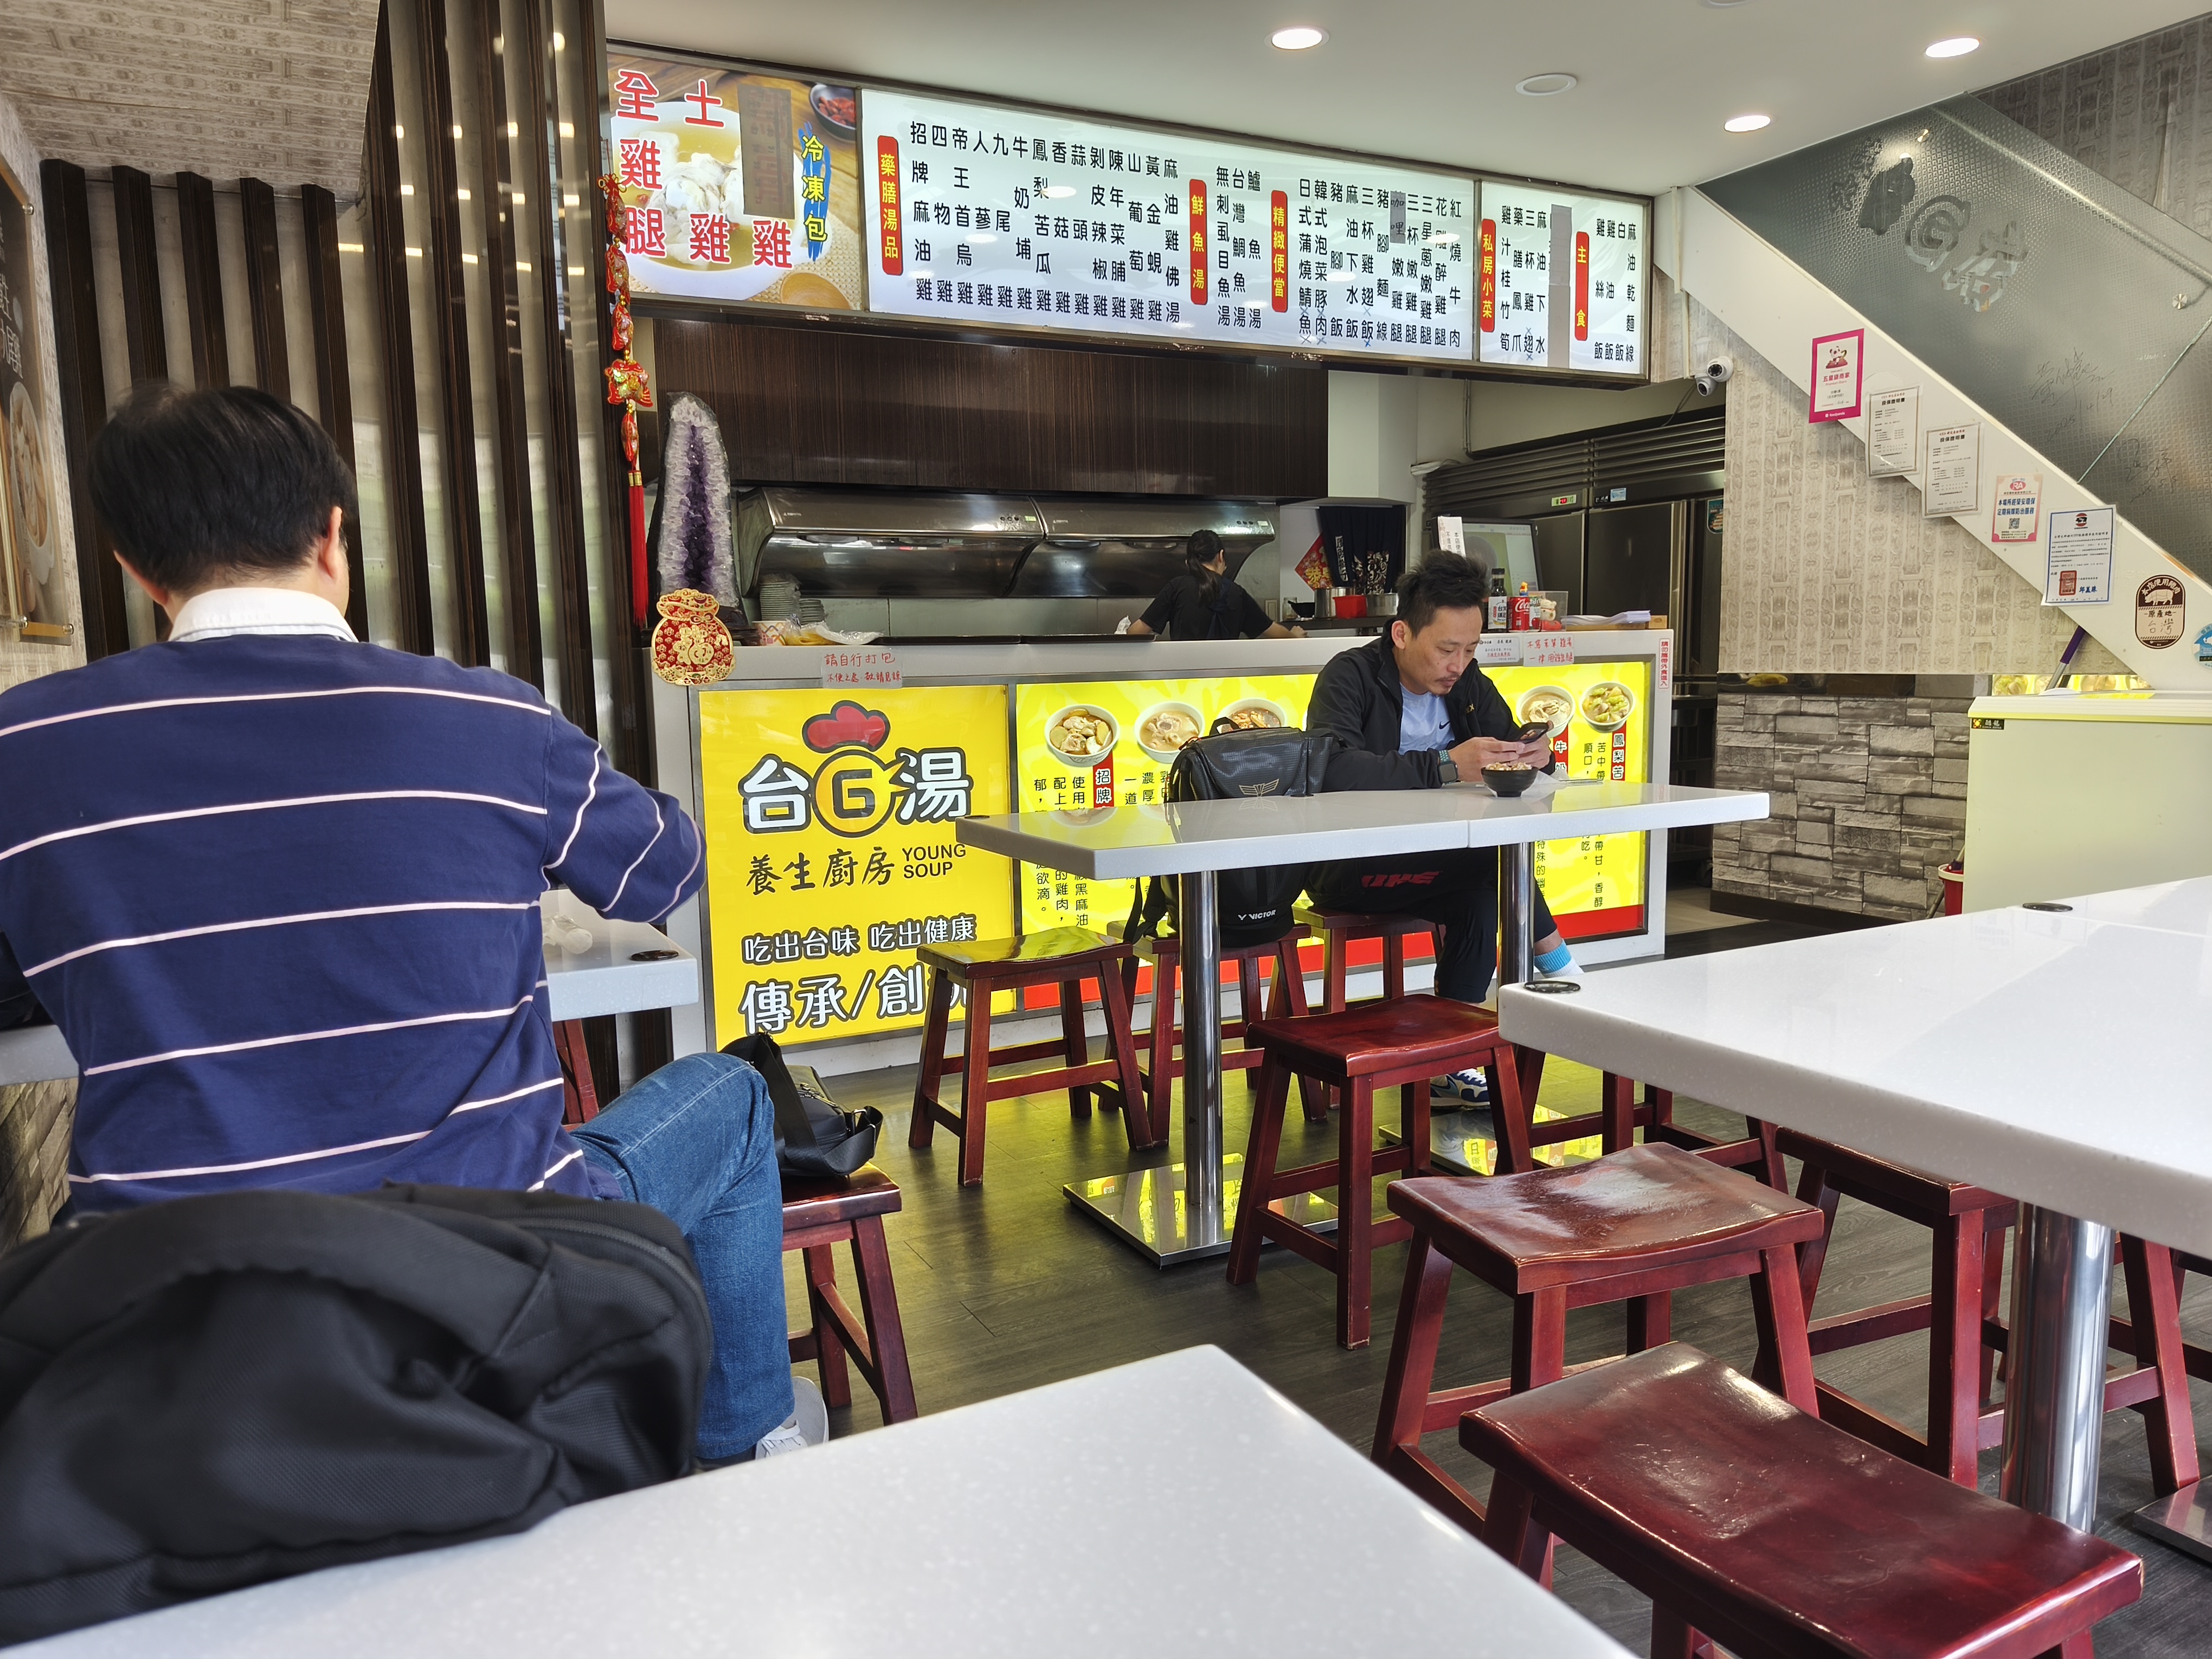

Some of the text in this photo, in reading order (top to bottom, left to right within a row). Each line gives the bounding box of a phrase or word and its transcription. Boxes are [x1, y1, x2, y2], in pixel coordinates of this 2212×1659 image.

[614, 69, 666, 258] 全雞腿
[801, 134, 828, 242] 冷凍包
[880, 154, 899, 259] 藥膳湯品
[910, 121, 933, 301] 招牌麻油雞
[932, 125, 953, 303] 四物雞
[952, 127, 974, 305] 帝王首烏雞
[973, 131, 993, 307] 人蔘雞
[992, 133, 1013, 308] 九尾雞
[1013, 136, 1032, 310] 牛奶埔雞
[1033, 139, 1052, 312] 鳳梨苦瓜雞
[1052, 142, 1071, 313] 香菇雞
[1071, 144, 1090, 316] 蒜頭雞
[1090, 147, 1108, 317] 剝皮辣椒雞
[1109, 150, 1127, 318] 陳年菜脯雞
[1128, 153, 1144, 320] 山葡萄雞
[1146, 156, 1162, 321] 黃金蜆雞
[1163, 158, 1180, 323] 麻油雞佛湯
[1192, 195, 1204, 290] 鮮魚湯
[1217, 166, 1231, 326] 無刺虱目魚湯
[1232, 168, 1246, 327] 台灣鯛魚湯
[1248, 170, 1262, 329] 鱸魚湯
[1274, 207, 1285, 298] 精緻便當
[1299, 179, 1312, 335] 日式蒲燒鯖魚
[1314, 181, 1328, 336] 韓式泡菜豚肉
[1330, 183, 1343, 337] 豬腳飯
[1346, 185, 1359, 338] 麻油下水飯
[1361, 188, 1374, 339] 三杯雞翅飯
[1377, 189, 1390, 341] 豬腳麵線
[1407, 194, 1419, 344] 三杯嫩雞腿
[1450, 200, 1462, 348] 紅燒牛肉
[1482, 234, 1493, 318] 私房小菜
[1500, 206, 1511, 351] 雞汁桂竹筍
[1512, 208, 1523, 352] 藥膳鳳爪
[1524, 210, 1535, 353] 三杯雞翅
[1535, 211, 1547, 353] 麻油下水
[1576, 246, 1586, 327] 主食
[1594, 218, 1604, 360] 雞絲飯
[1605, 220, 1615, 361] 雞油飯
[1615, 222, 1625, 361] 白飯
[1625, 223, 1636, 362] 麻油乾麵線
[2148, 618, 2174, 635] 台灣
[902, 843, 966, 861] YOUNG
[1054, 777, 1066, 811] 配上
[1072, 776, 1085, 810] 使用
[1096, 768, 1111, 808] 招牌
[1142, 772, 1154, 805] 濃厚
[743, 914, 977, 964] 吃出台味 吃出健康
[746, 845, 896, 896] 養生廚房
[903, 861, 953, 879] SOUP
[1249, 909, 1276, 920] VICTOR
[1594, 834, 1603, 908] 帶甘,香醇
[739, 962, 969, 1034] 傳承/創
